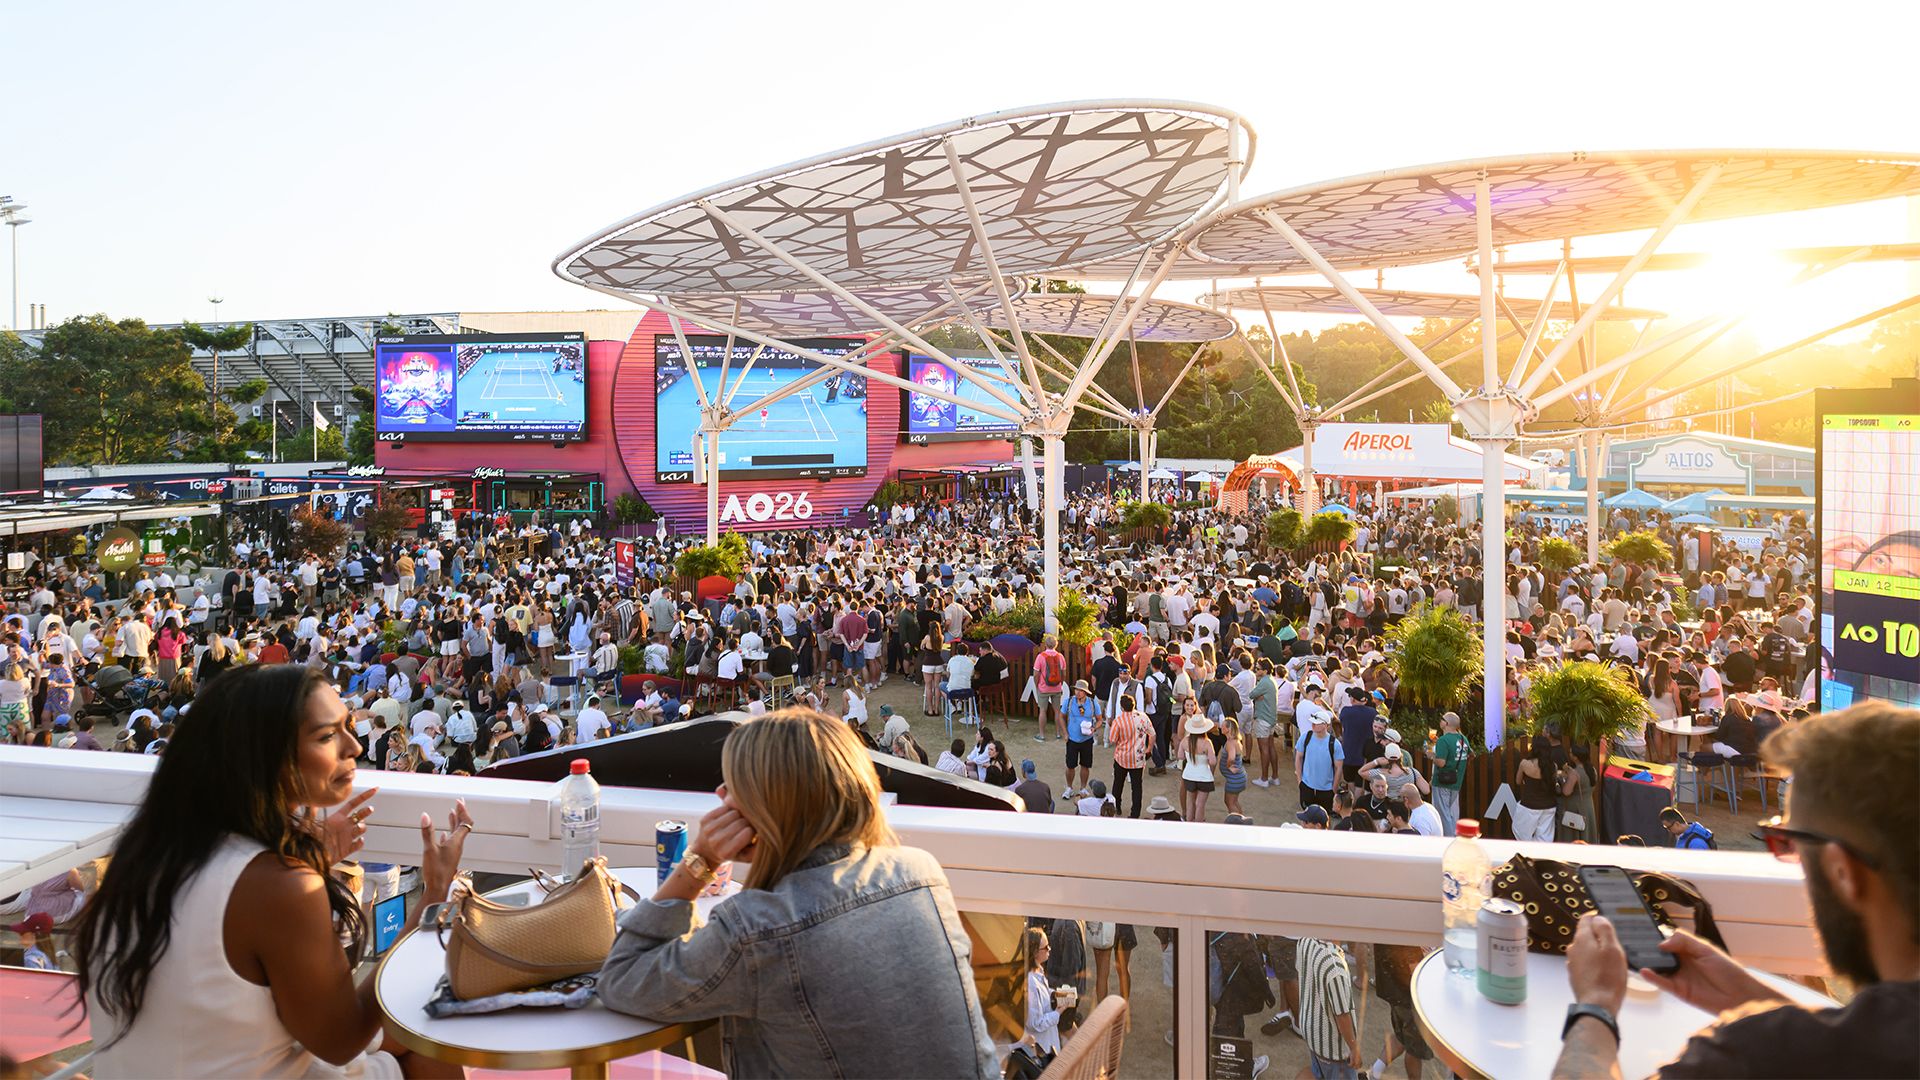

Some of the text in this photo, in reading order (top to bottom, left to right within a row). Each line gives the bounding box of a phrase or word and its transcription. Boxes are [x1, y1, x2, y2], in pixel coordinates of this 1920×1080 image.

[1848, 418, 1880, 427] TOPCOURT
[379, 432, 404, 440] KIA
[1343, 431, 1413, 451] APEROL
[1668, 452, 1714, 468] ALTOS
[660, 472, 688, 481] KIA
[264, 482, 298, 494] oilets
[719, 491, 813, 523] AO26
[104, 540, 134, 557] Asahi
[1847, 577, 1892, 591] JAN 12
[1840, 622, 1879, 643] AO
[383, 923, 399, 934] Entry
